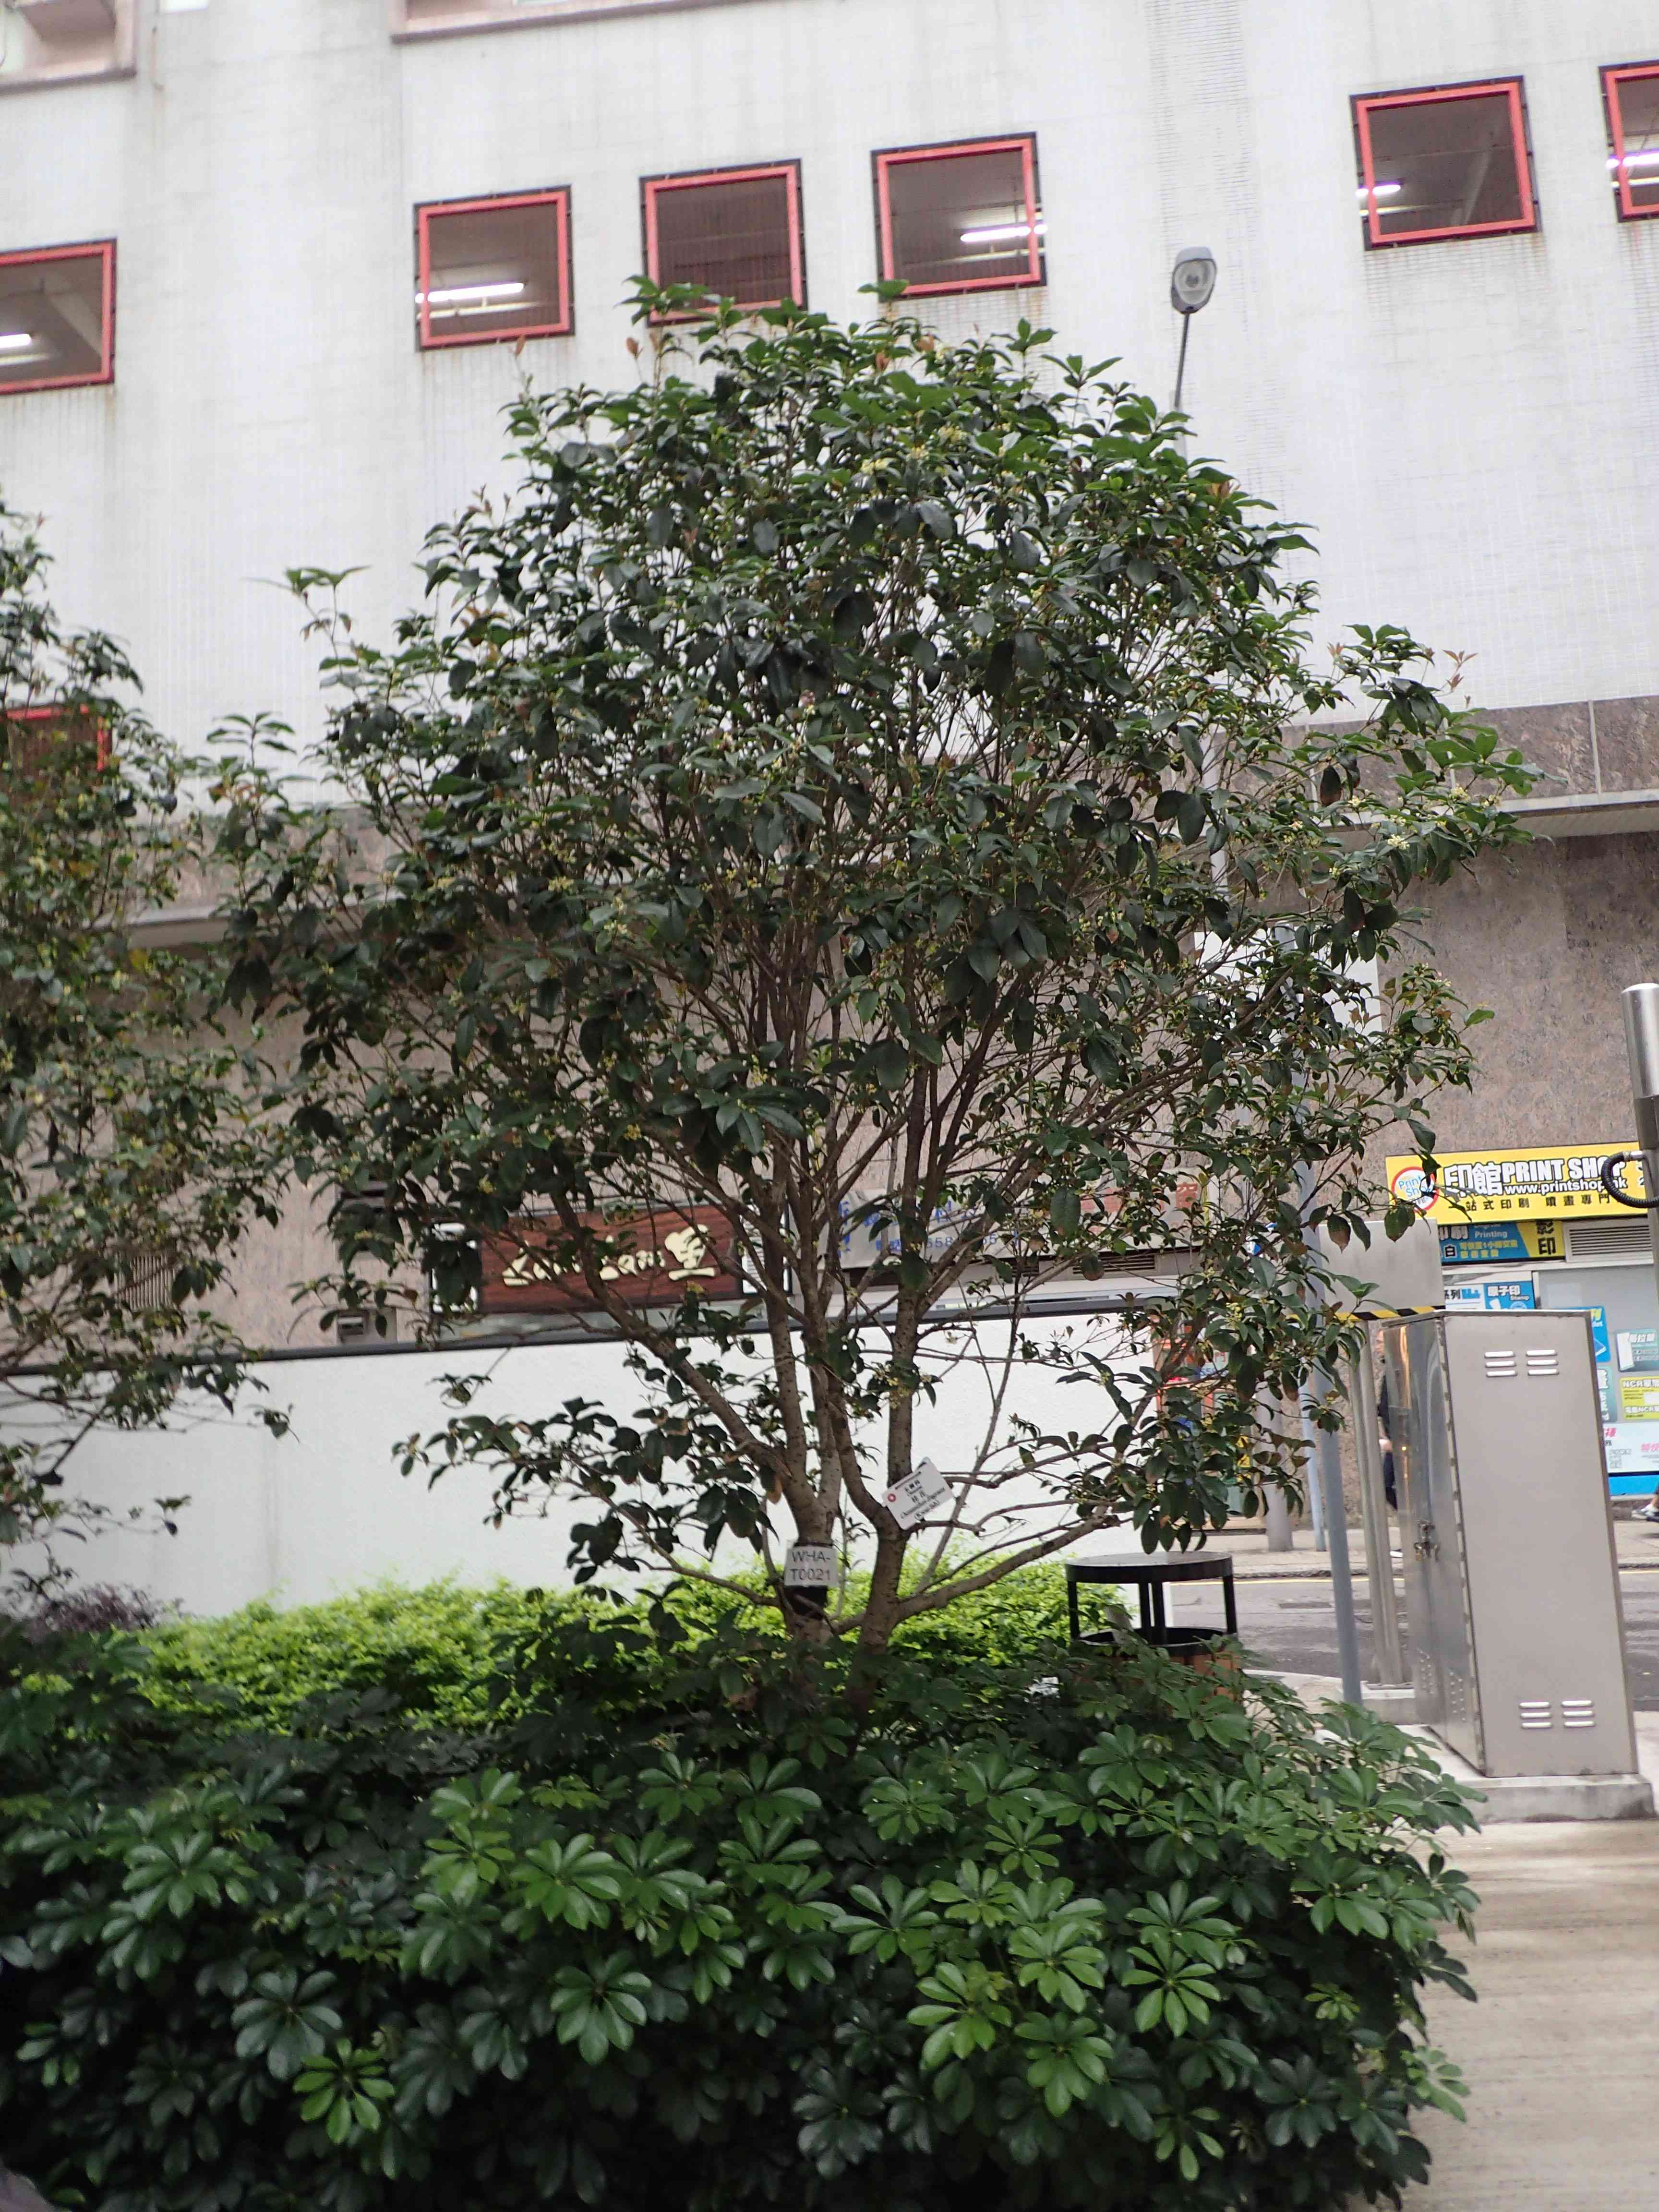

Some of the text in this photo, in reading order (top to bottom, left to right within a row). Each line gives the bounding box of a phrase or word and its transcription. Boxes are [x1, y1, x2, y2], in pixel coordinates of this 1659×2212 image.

[1444, 1161, 1502, 1197] 印館
[1502, 1158, 1565, 1184] PRINT
[1503, 1176, 1628, 1195] www.printshopk
[1475, 1230, 1508, 1239] Printing
[792, 1550, 830, 1562] WHA-
[790, 1568, 830, 1581] T0021
